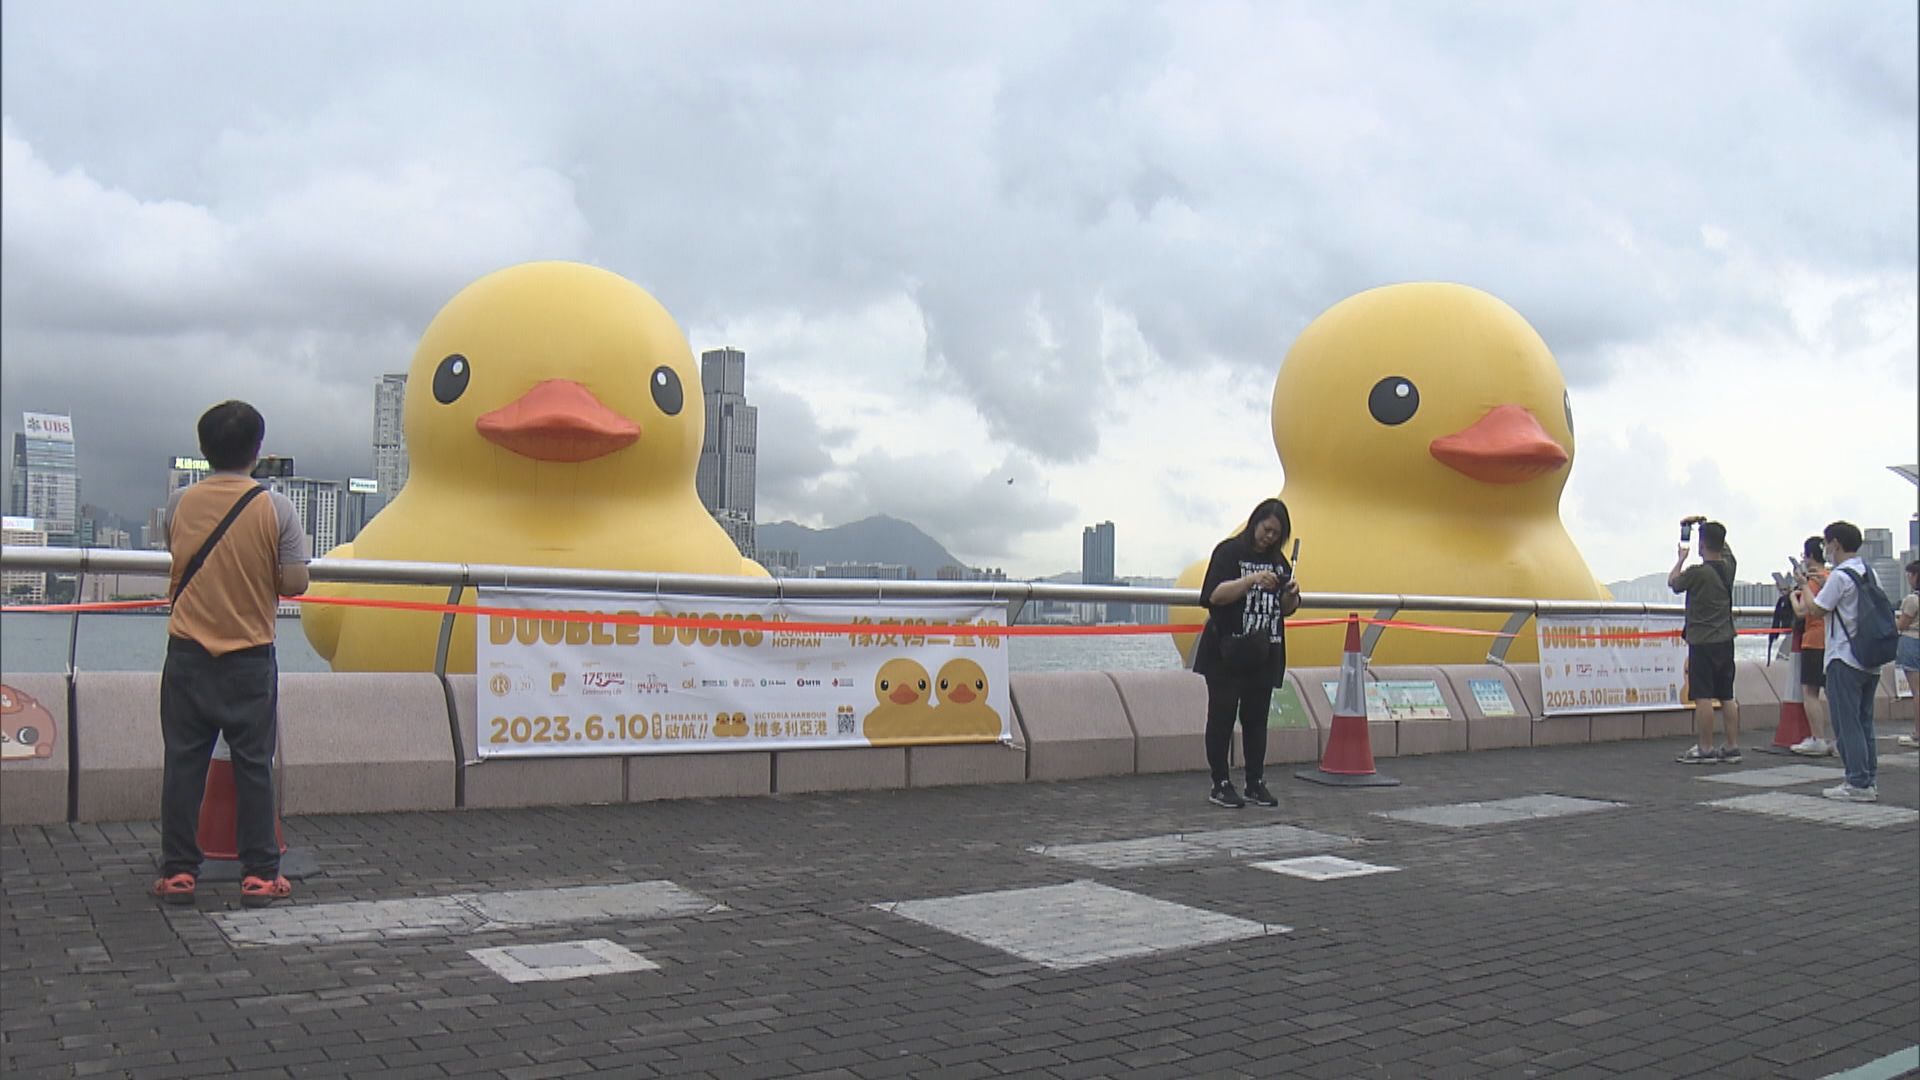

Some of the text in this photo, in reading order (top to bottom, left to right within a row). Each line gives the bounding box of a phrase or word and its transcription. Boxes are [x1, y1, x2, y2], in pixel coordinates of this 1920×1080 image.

[43, 421, 70, 432] UBS
[489, 610, 763, 647] DOUBLE DUCKS
[772, 638, 821, 648] HOFMAN
[1542, 626, 1596, 648] DOUBLE
[582, 672, 603, 686] 175
[1546, 688, 1602, 708] 2023.6.10
[664, 713, 708, 721] EMBARKS
[754, 711, 827, 720] VICTORIA HARBOUR
[490, 714, 649, 743] 2023.6.10
[754, 719, 827, 737] 維多利亞港
